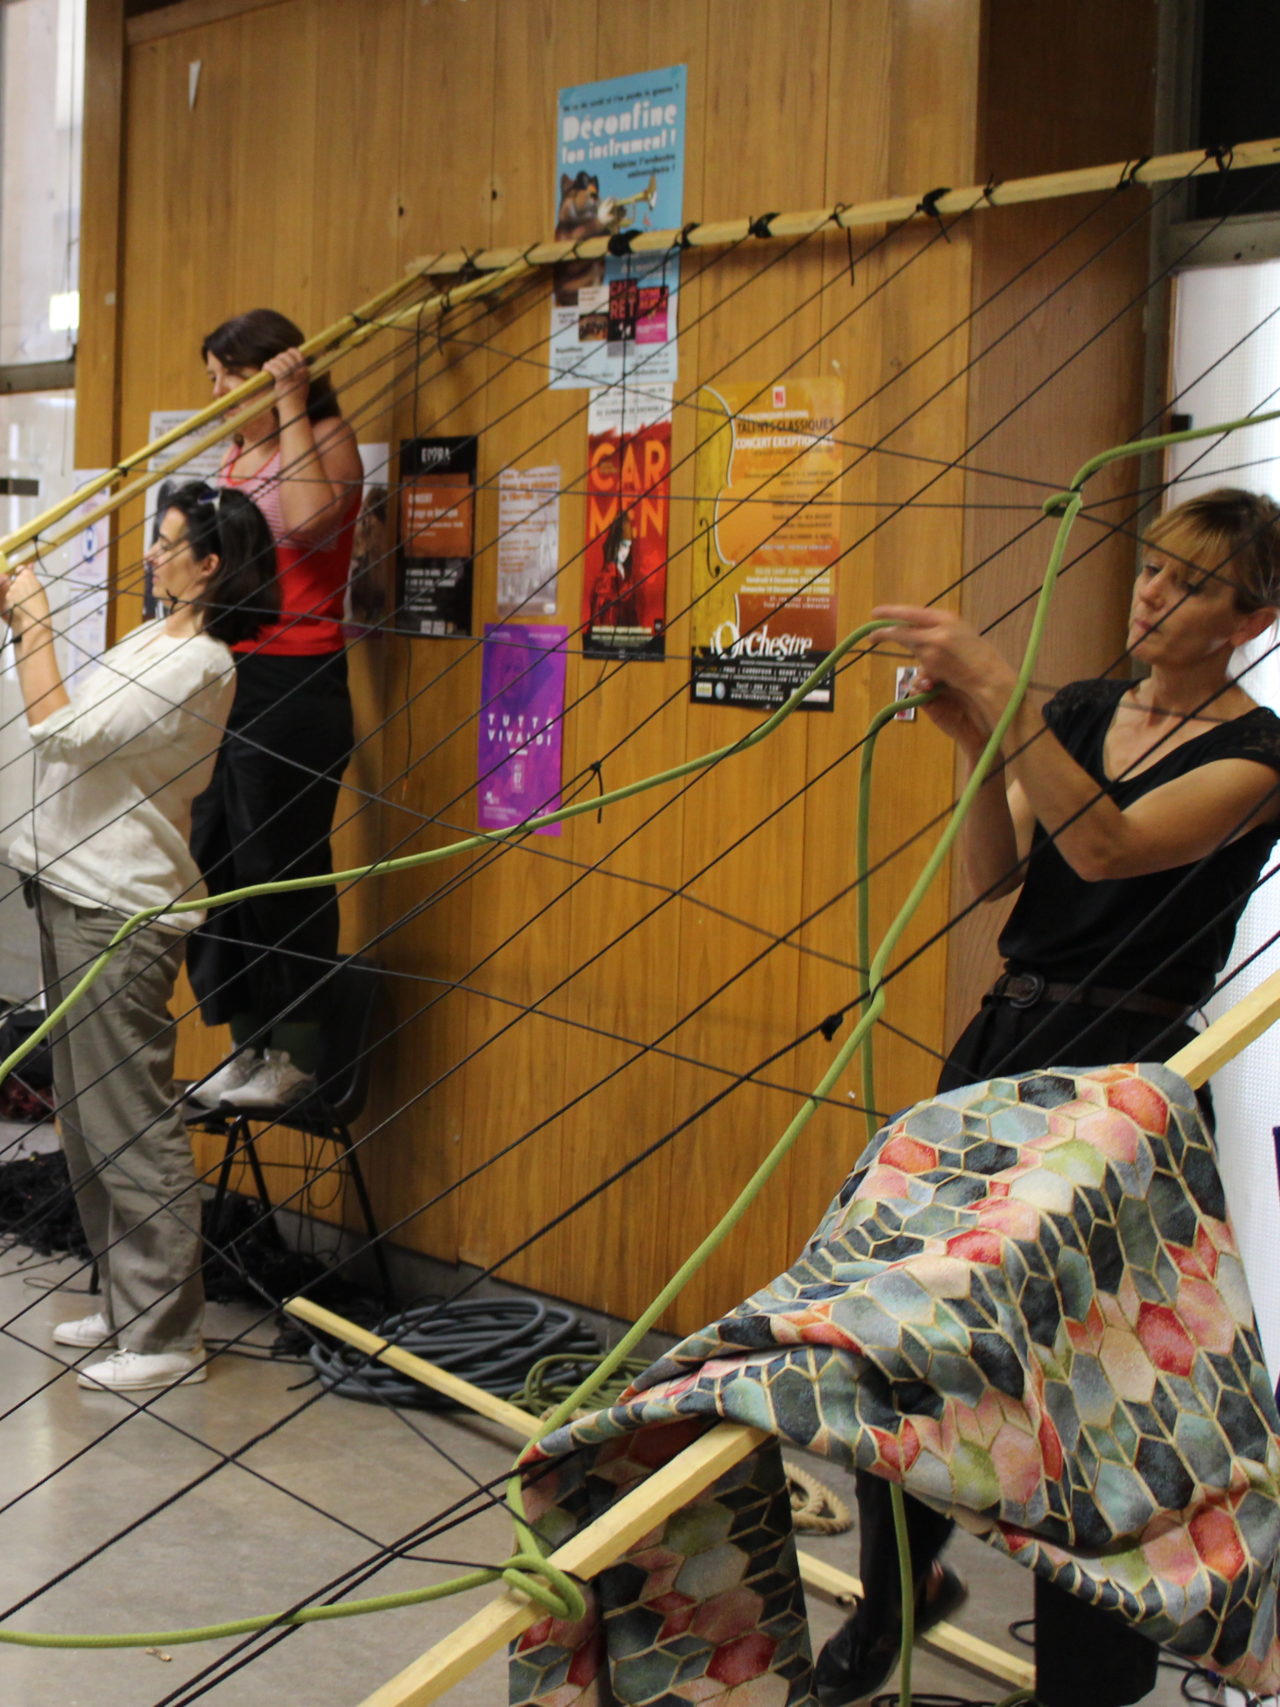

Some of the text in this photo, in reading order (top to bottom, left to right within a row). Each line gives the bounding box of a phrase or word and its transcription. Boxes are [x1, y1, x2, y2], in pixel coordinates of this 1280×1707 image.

[562, 100, 678, 143] Déconfine
[562, 145, 585, 164] ton
[589, 128, 667, 160] instrument
[737, 417, 834, 434] TALENTS CLASSIQUES
[734, 437, 771, 449] CONCERT
[591, 440, 667, 491] CAR
[488, 713, 554, 731] TUTTO
[488, 729, 552, 747] VIVALDI
